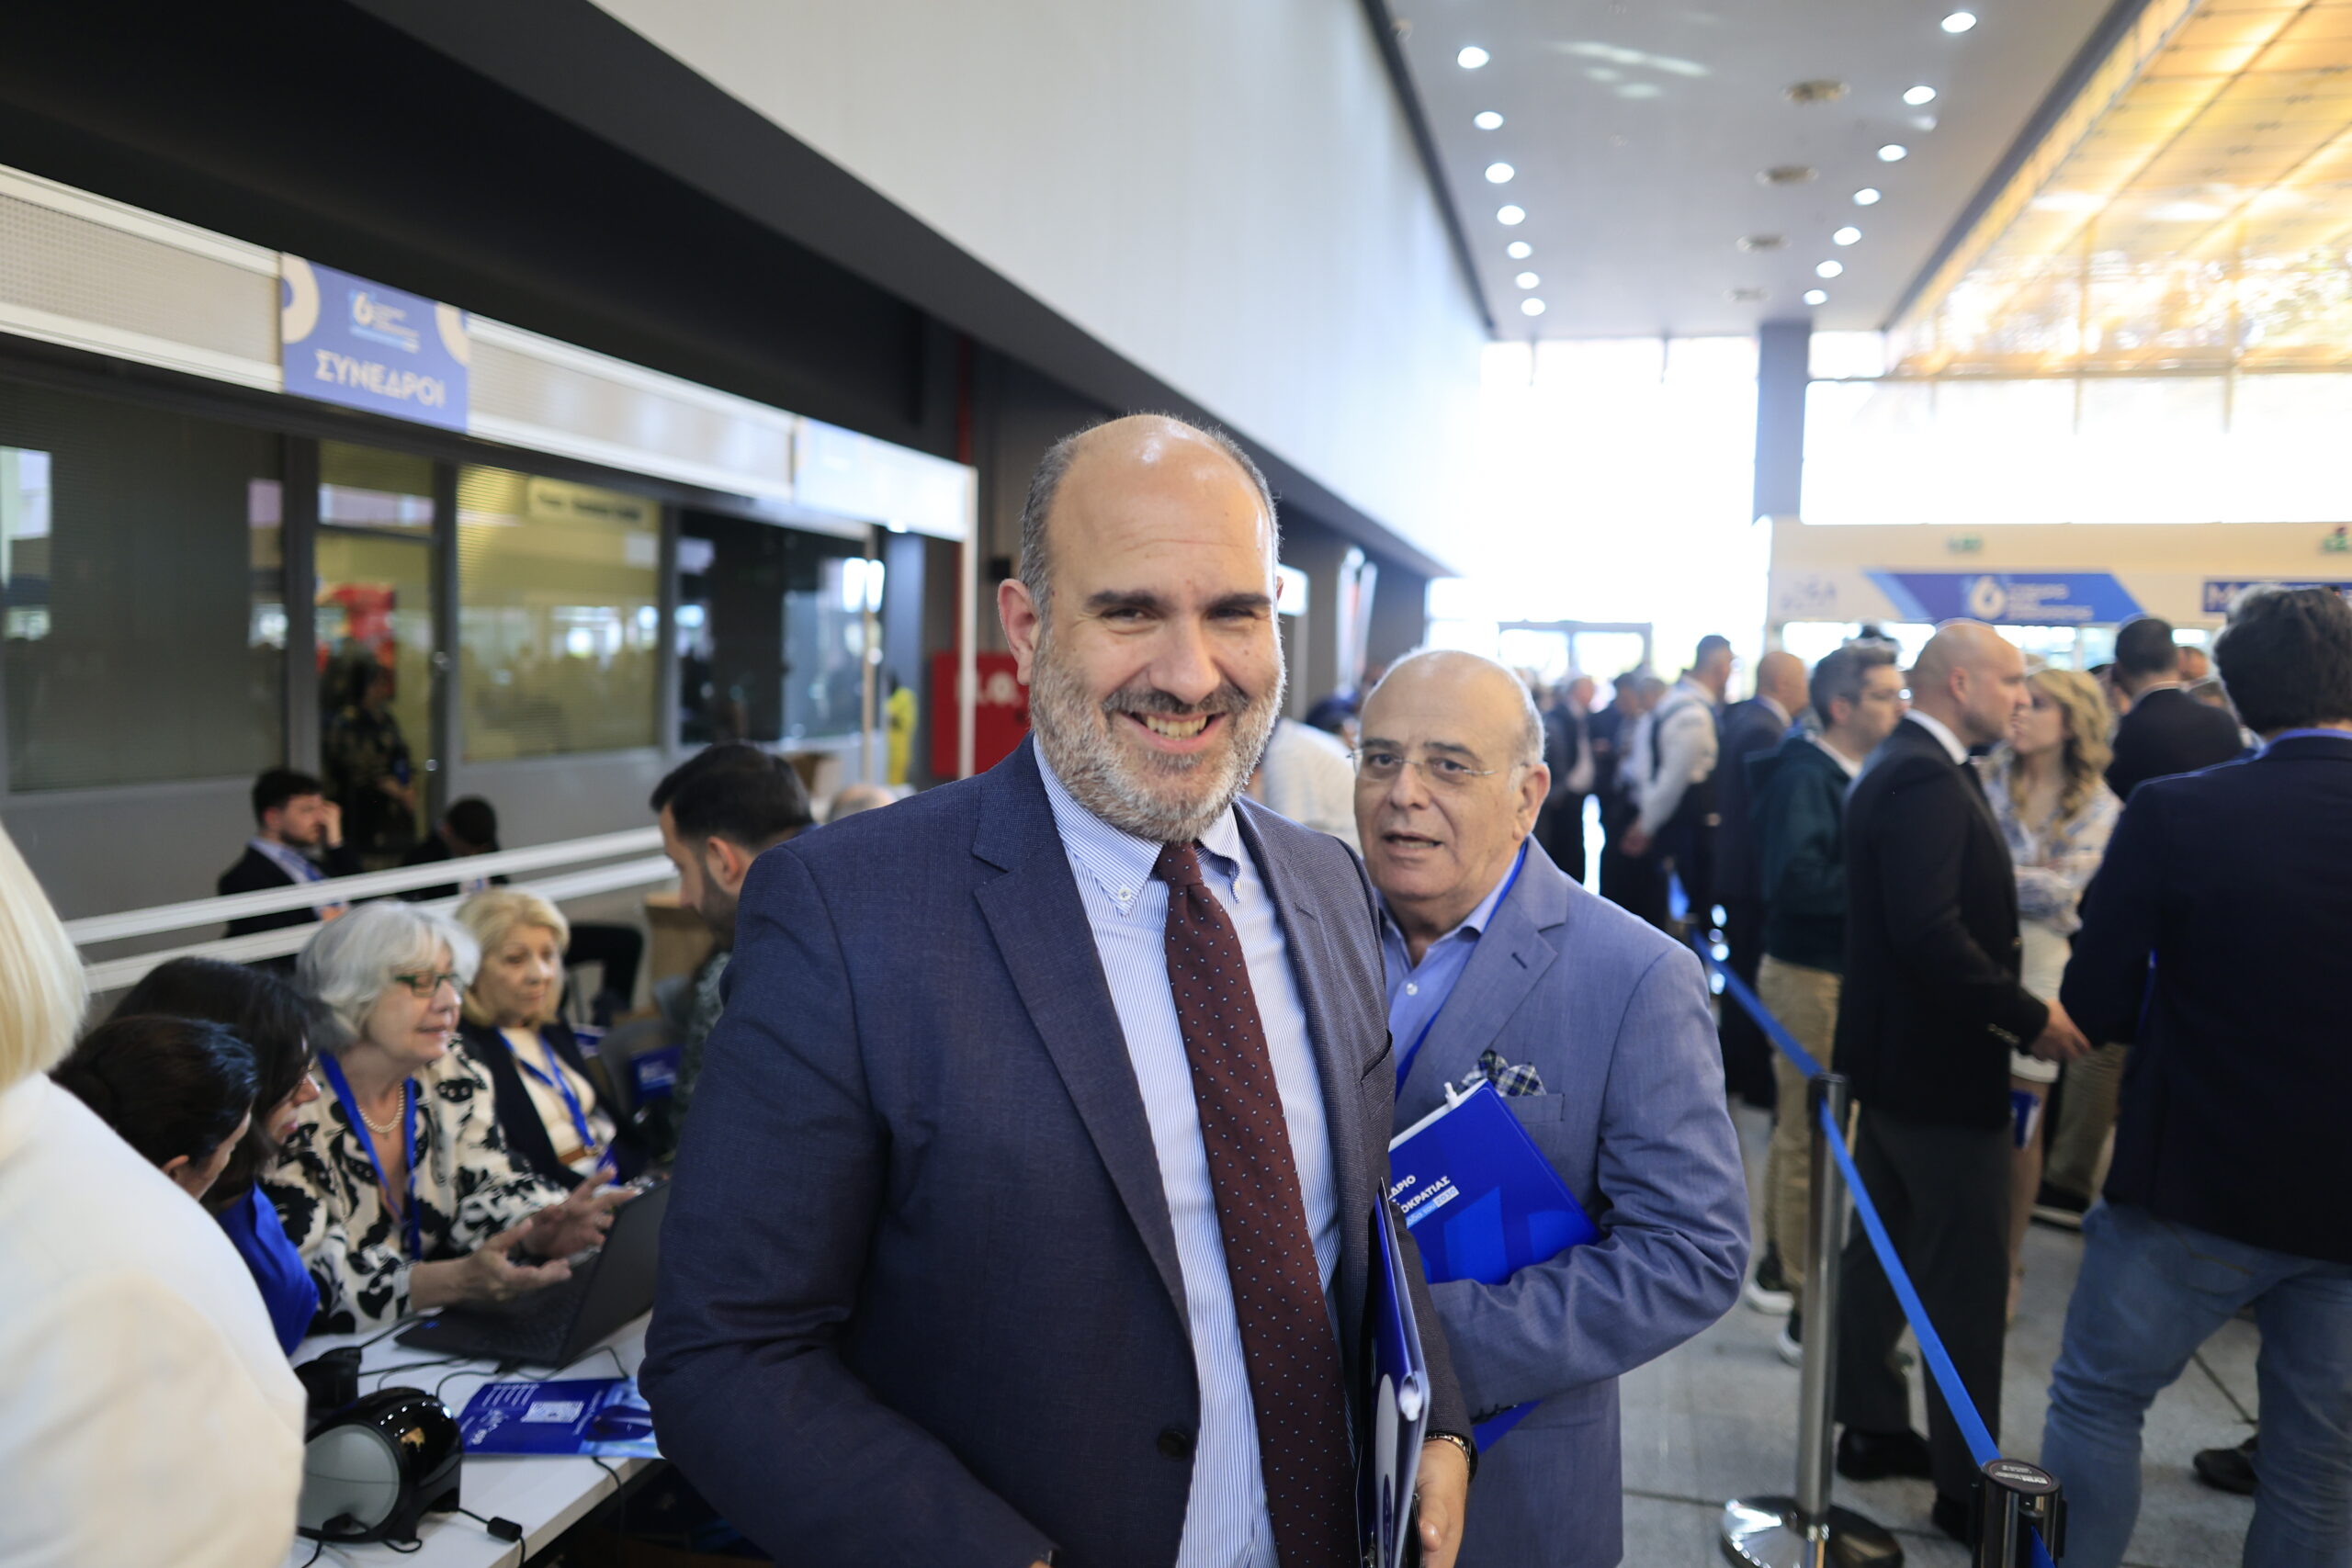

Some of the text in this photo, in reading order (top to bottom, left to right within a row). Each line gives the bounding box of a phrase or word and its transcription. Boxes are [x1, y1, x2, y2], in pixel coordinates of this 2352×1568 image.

[314, 348, 446, 409] ΣΥΝΕΔΡΟΙ
[1969, 575, 2006, 620] 6
[1435, 1187, 1457, 1204] 2030
